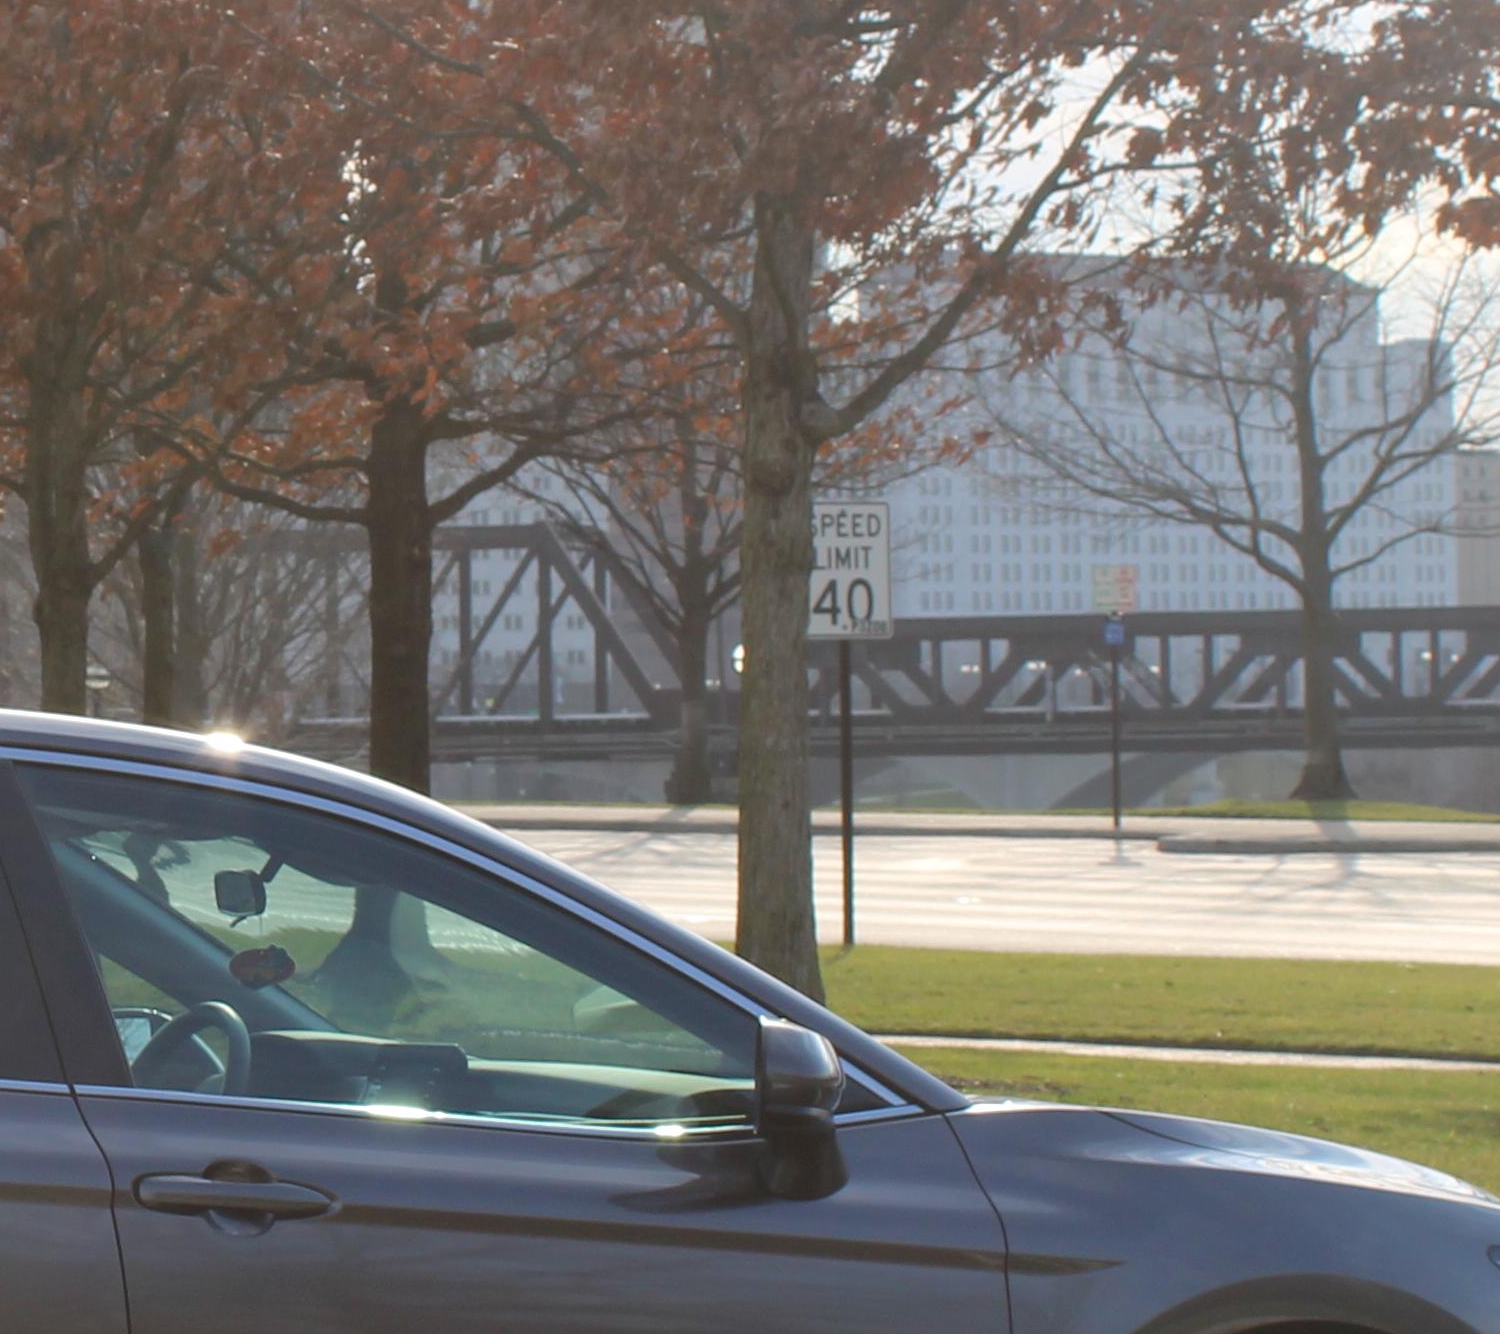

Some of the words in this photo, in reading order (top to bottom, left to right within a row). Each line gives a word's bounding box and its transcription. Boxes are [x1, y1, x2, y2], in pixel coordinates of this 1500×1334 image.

[810, 513, 881, 538] SPEED
[813, 546, 872, 570] LIMIT
[812, 577, 874, 626] 40
